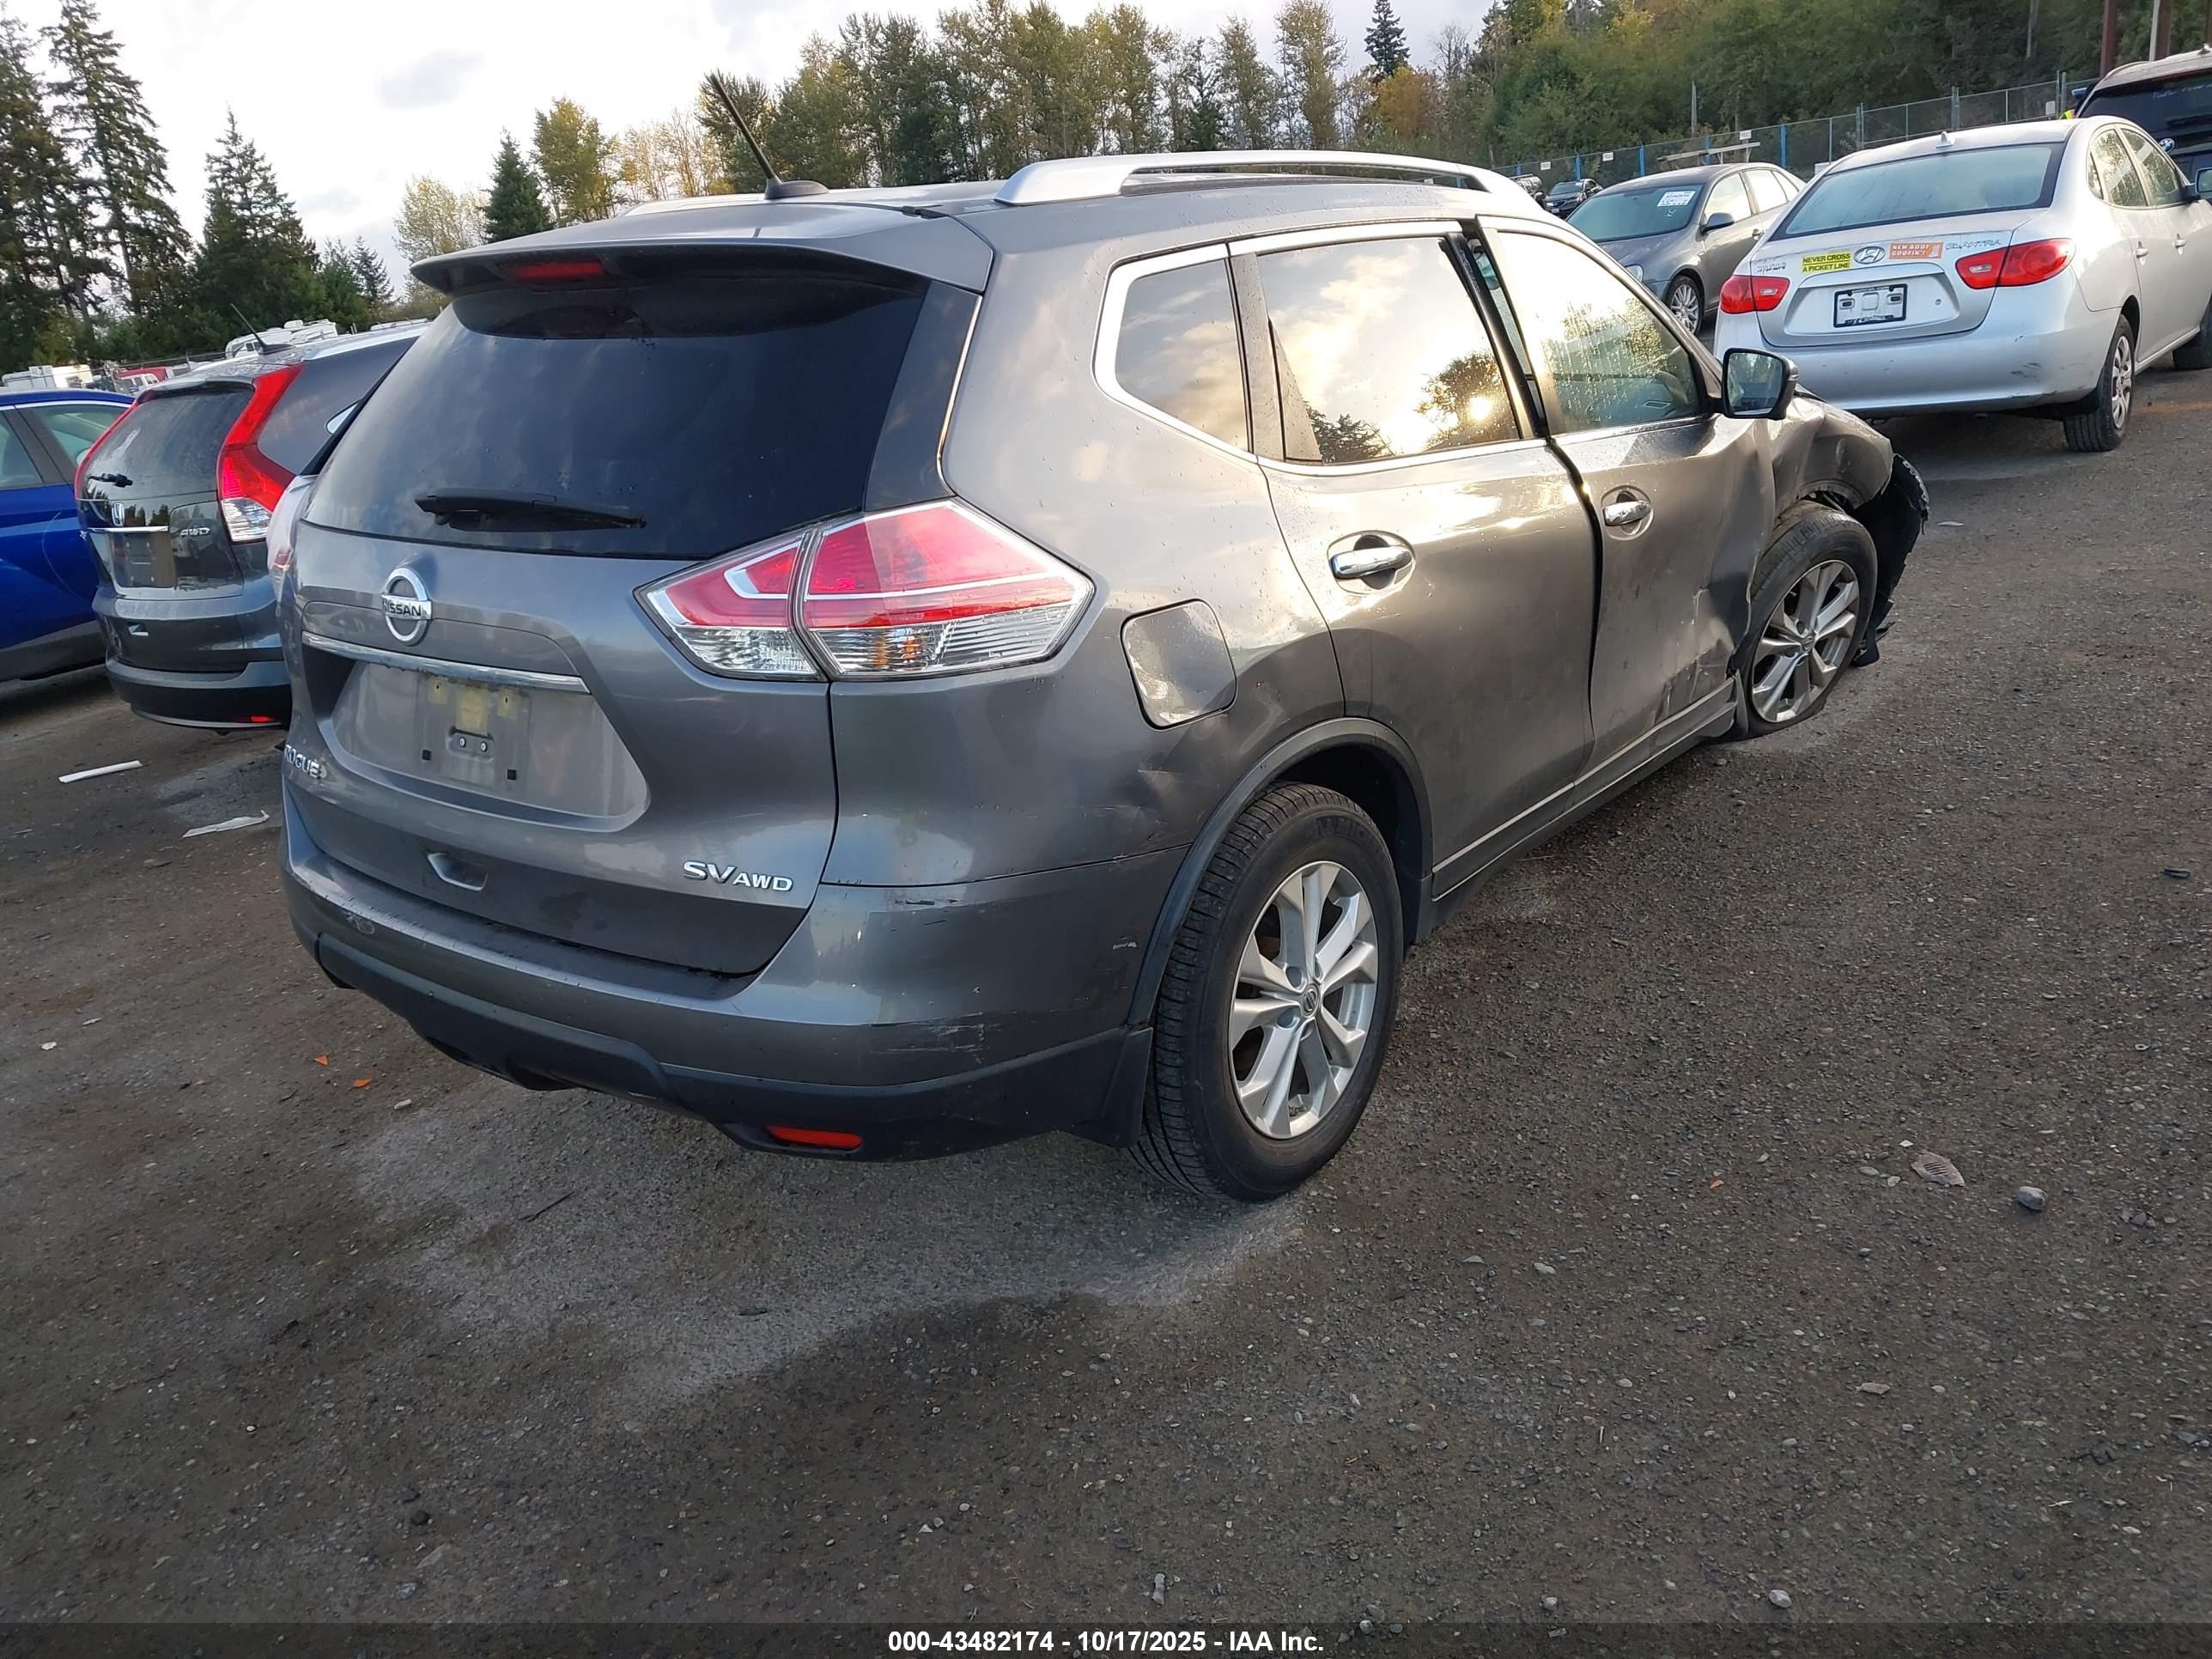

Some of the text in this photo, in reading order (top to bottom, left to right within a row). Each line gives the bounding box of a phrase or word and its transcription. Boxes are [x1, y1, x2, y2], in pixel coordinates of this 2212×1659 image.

[1802, 252, 1851, 264] NEVER CROSS
[1808, 264, 1833, 272] PICKET
[179, 526, 210, 536] AWD
[382, 599, 422, 617] NISSAN
[284, 744, 320, 779] ROGUE
[683, 860, 793, 891] SV AWD
